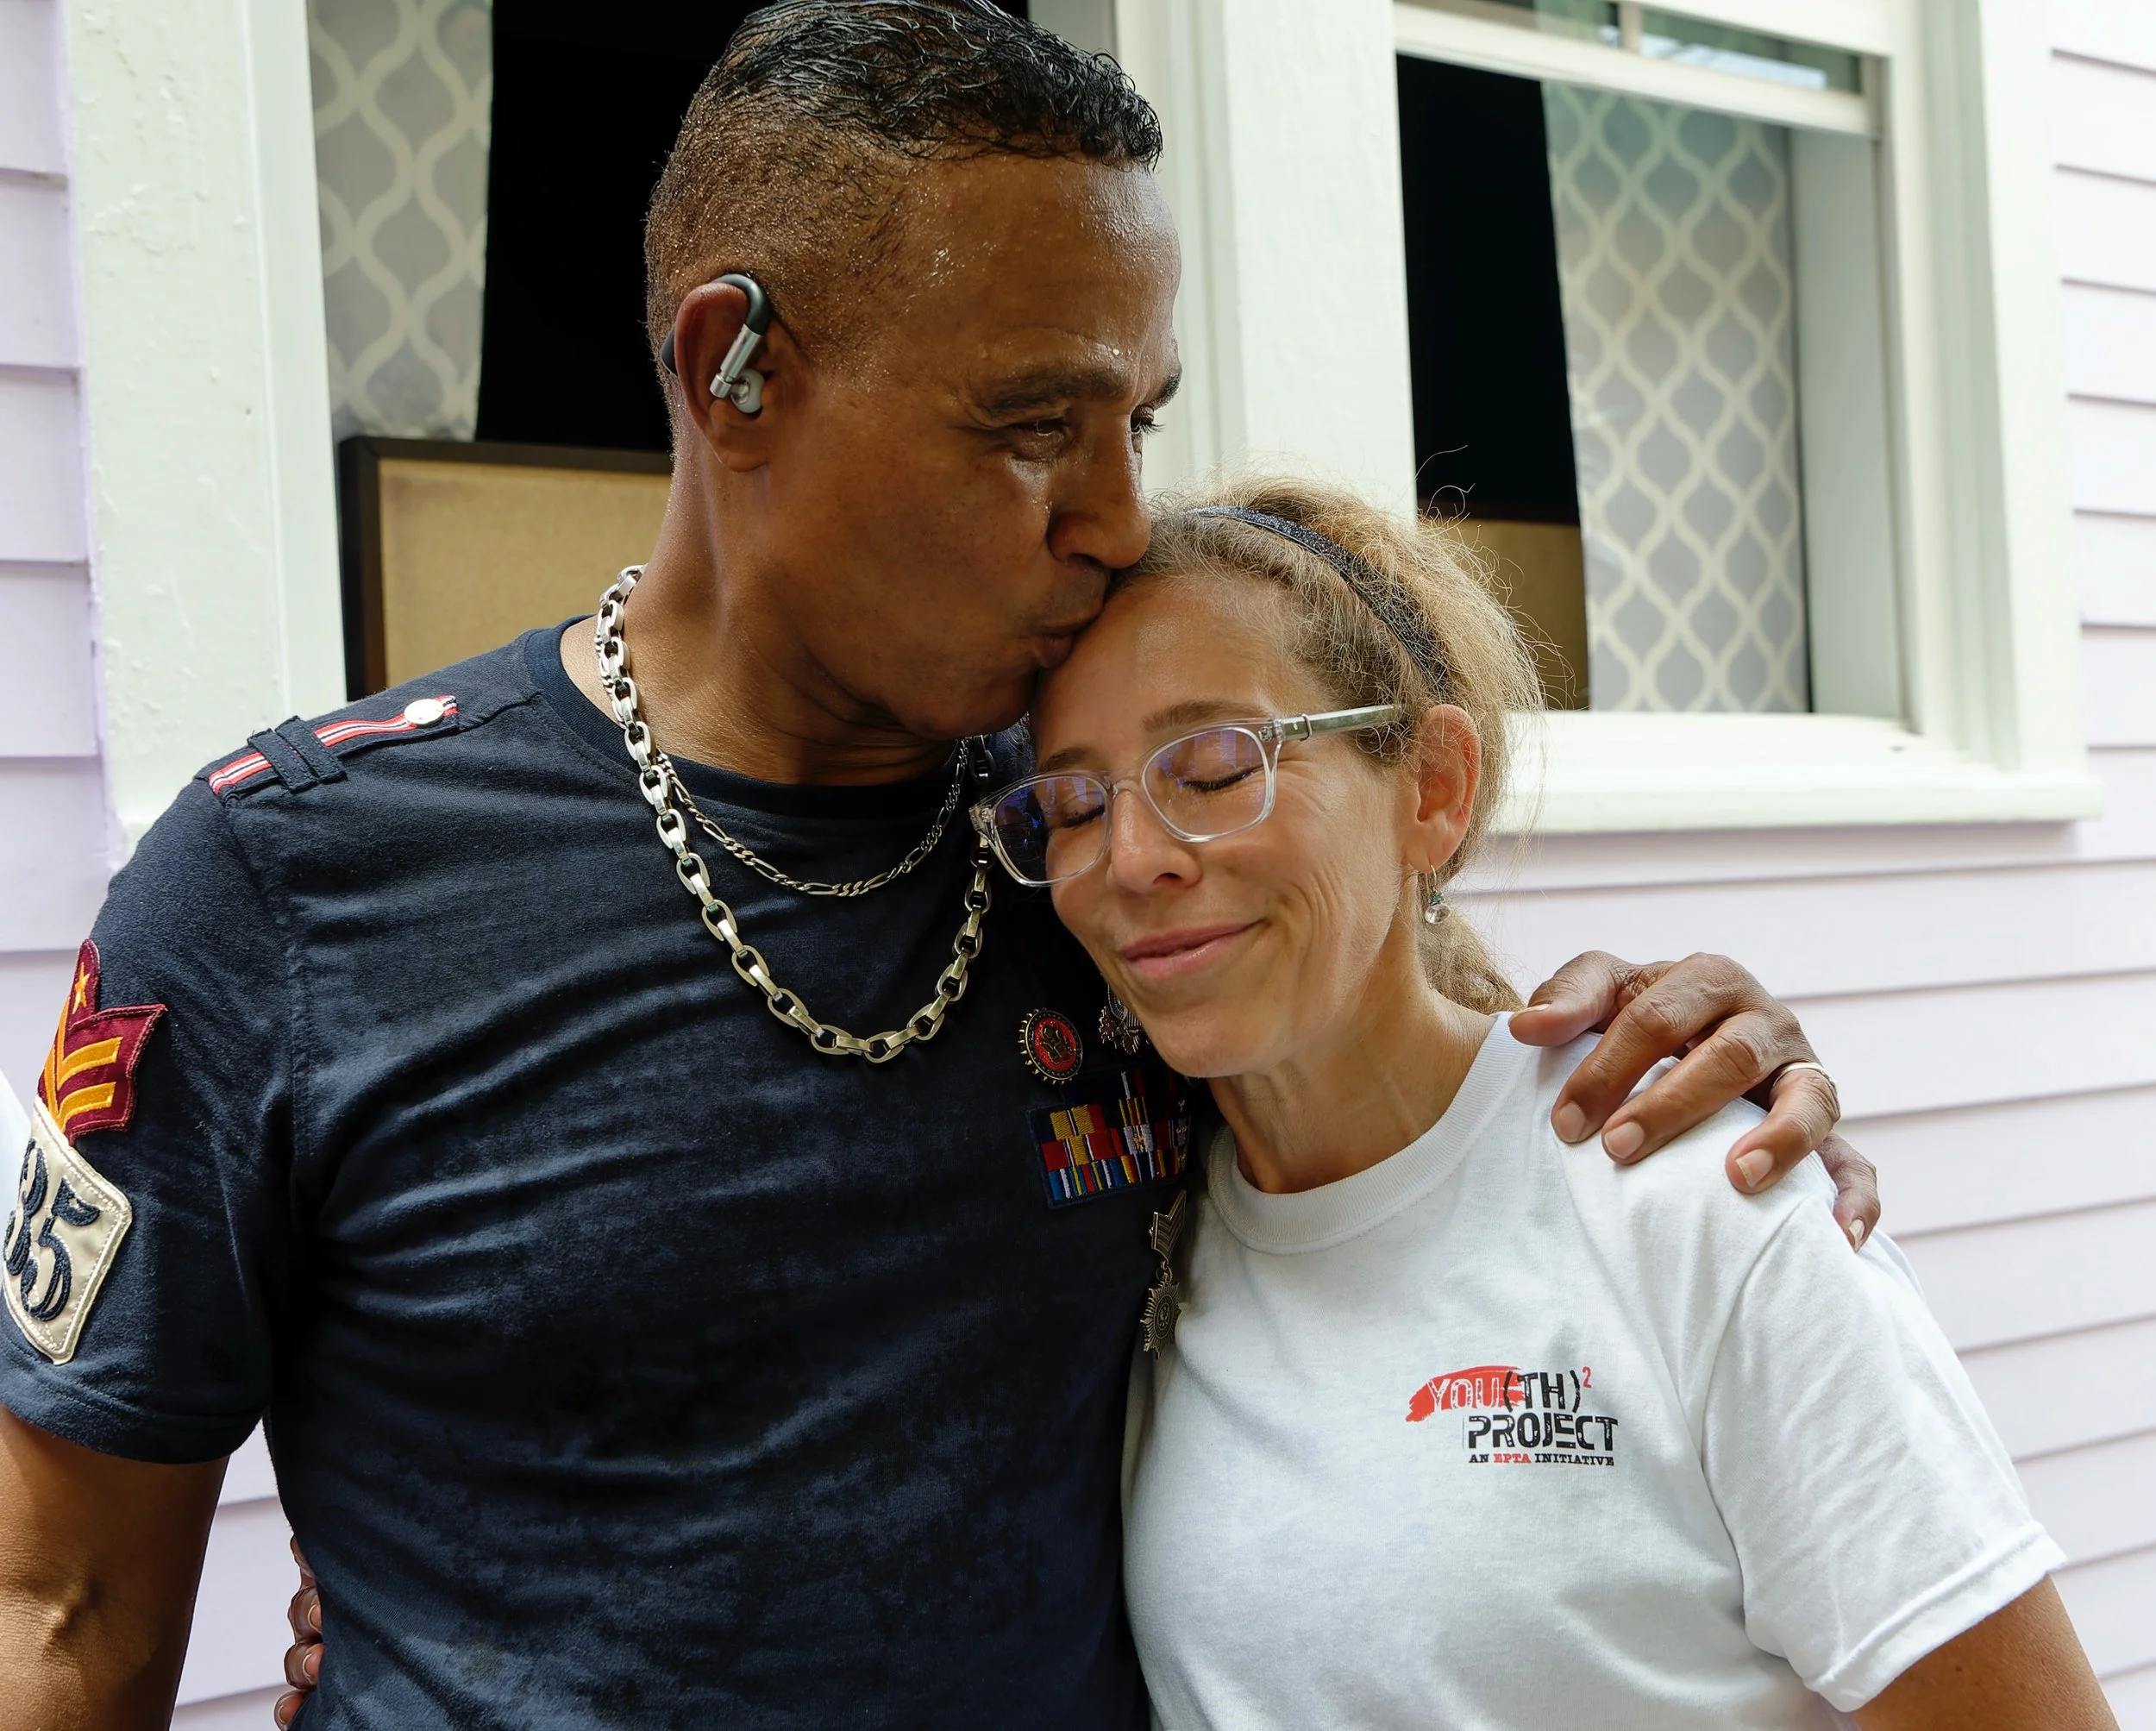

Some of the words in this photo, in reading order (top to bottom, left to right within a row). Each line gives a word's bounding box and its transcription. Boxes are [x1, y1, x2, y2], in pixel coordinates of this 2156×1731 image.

[1468, 1412, 1619, 1452] PROJECT
[1468, 1453, 1489, 1464] AN
[1493, 1453, 1532, 1464] EPTA
[1534, 1453, 1614, 1466] INITIATIVE
